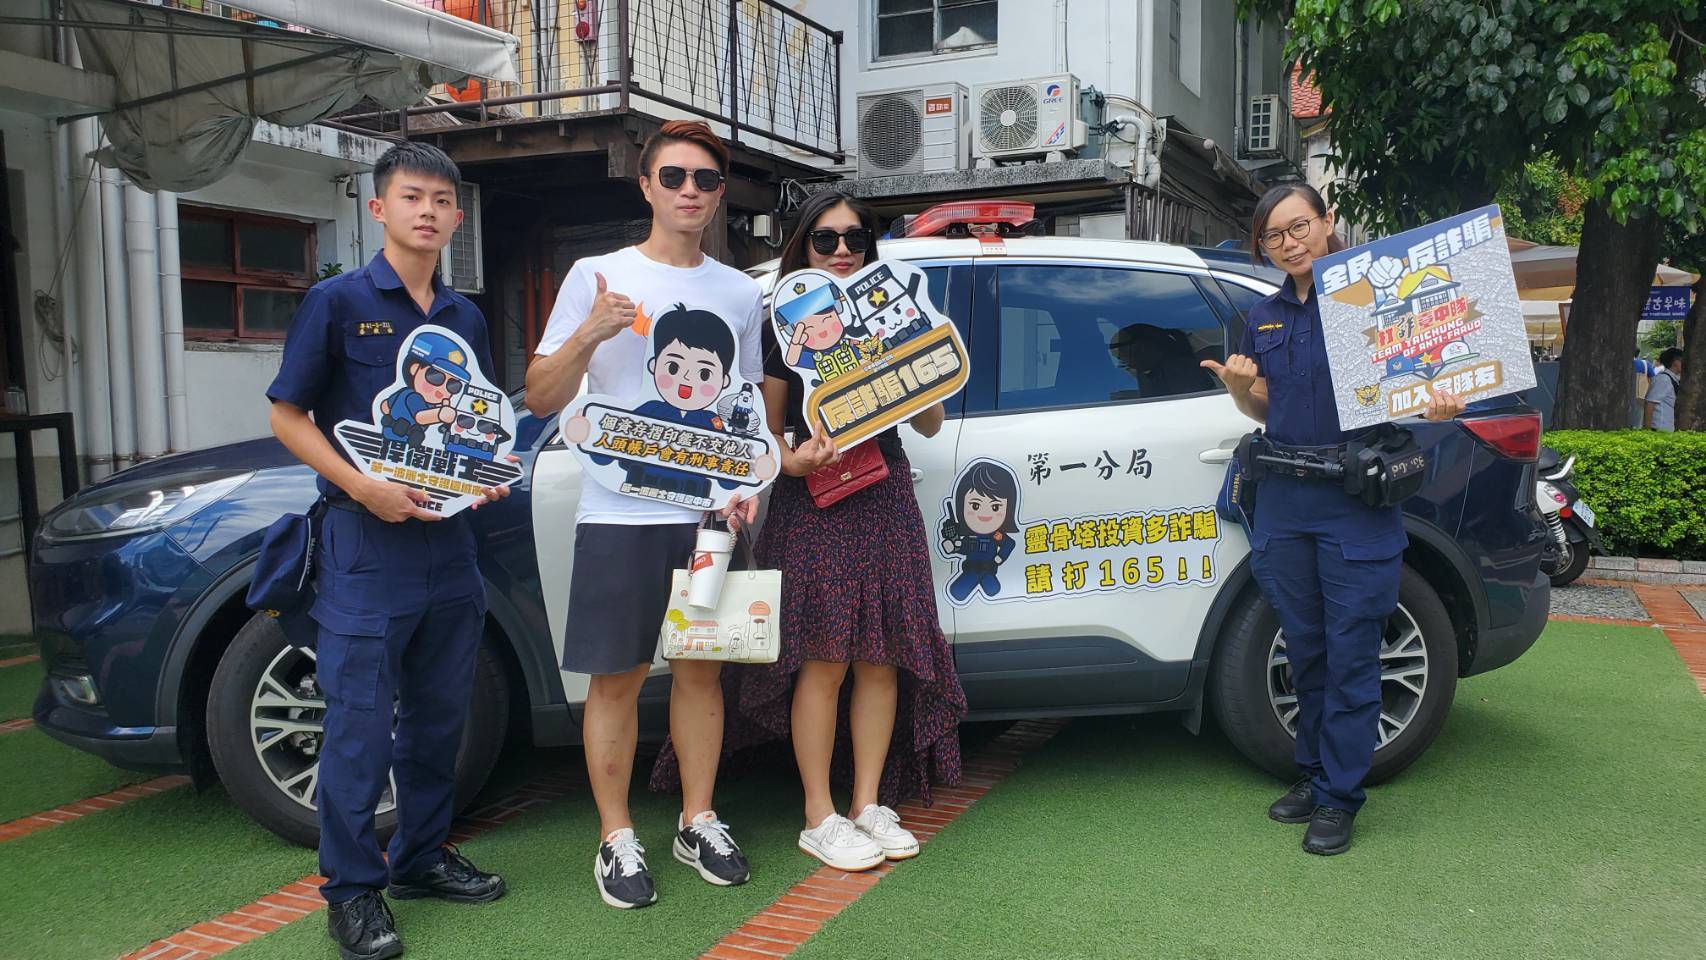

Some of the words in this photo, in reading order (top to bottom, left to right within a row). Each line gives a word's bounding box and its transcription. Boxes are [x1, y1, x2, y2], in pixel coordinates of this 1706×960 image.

[1321, 250, 1373, 295] 全民
[1408, 213, 1493, 273] 反詐騙
[854, 271, 885, 295] POLICE
[1371, 343, 1402, 363] TEAM
[1405, 318, 1464, 346] TAICHUNG
[1403, 346, 1418, 358] OF
[1419, 319, 1482, 352] ANTI-FRAUD
[467, 386, 500, 401] POLICE
[594, 433, 751, 477] 人頭帳戶會有刑事責任
[599, 413, 752, 460] 個資存摺印鑑不交他人
[1027, 448, 1153, 486] 第一分局
[1024, 510, 1218, 554] 靈骨塔投資多詐騙
